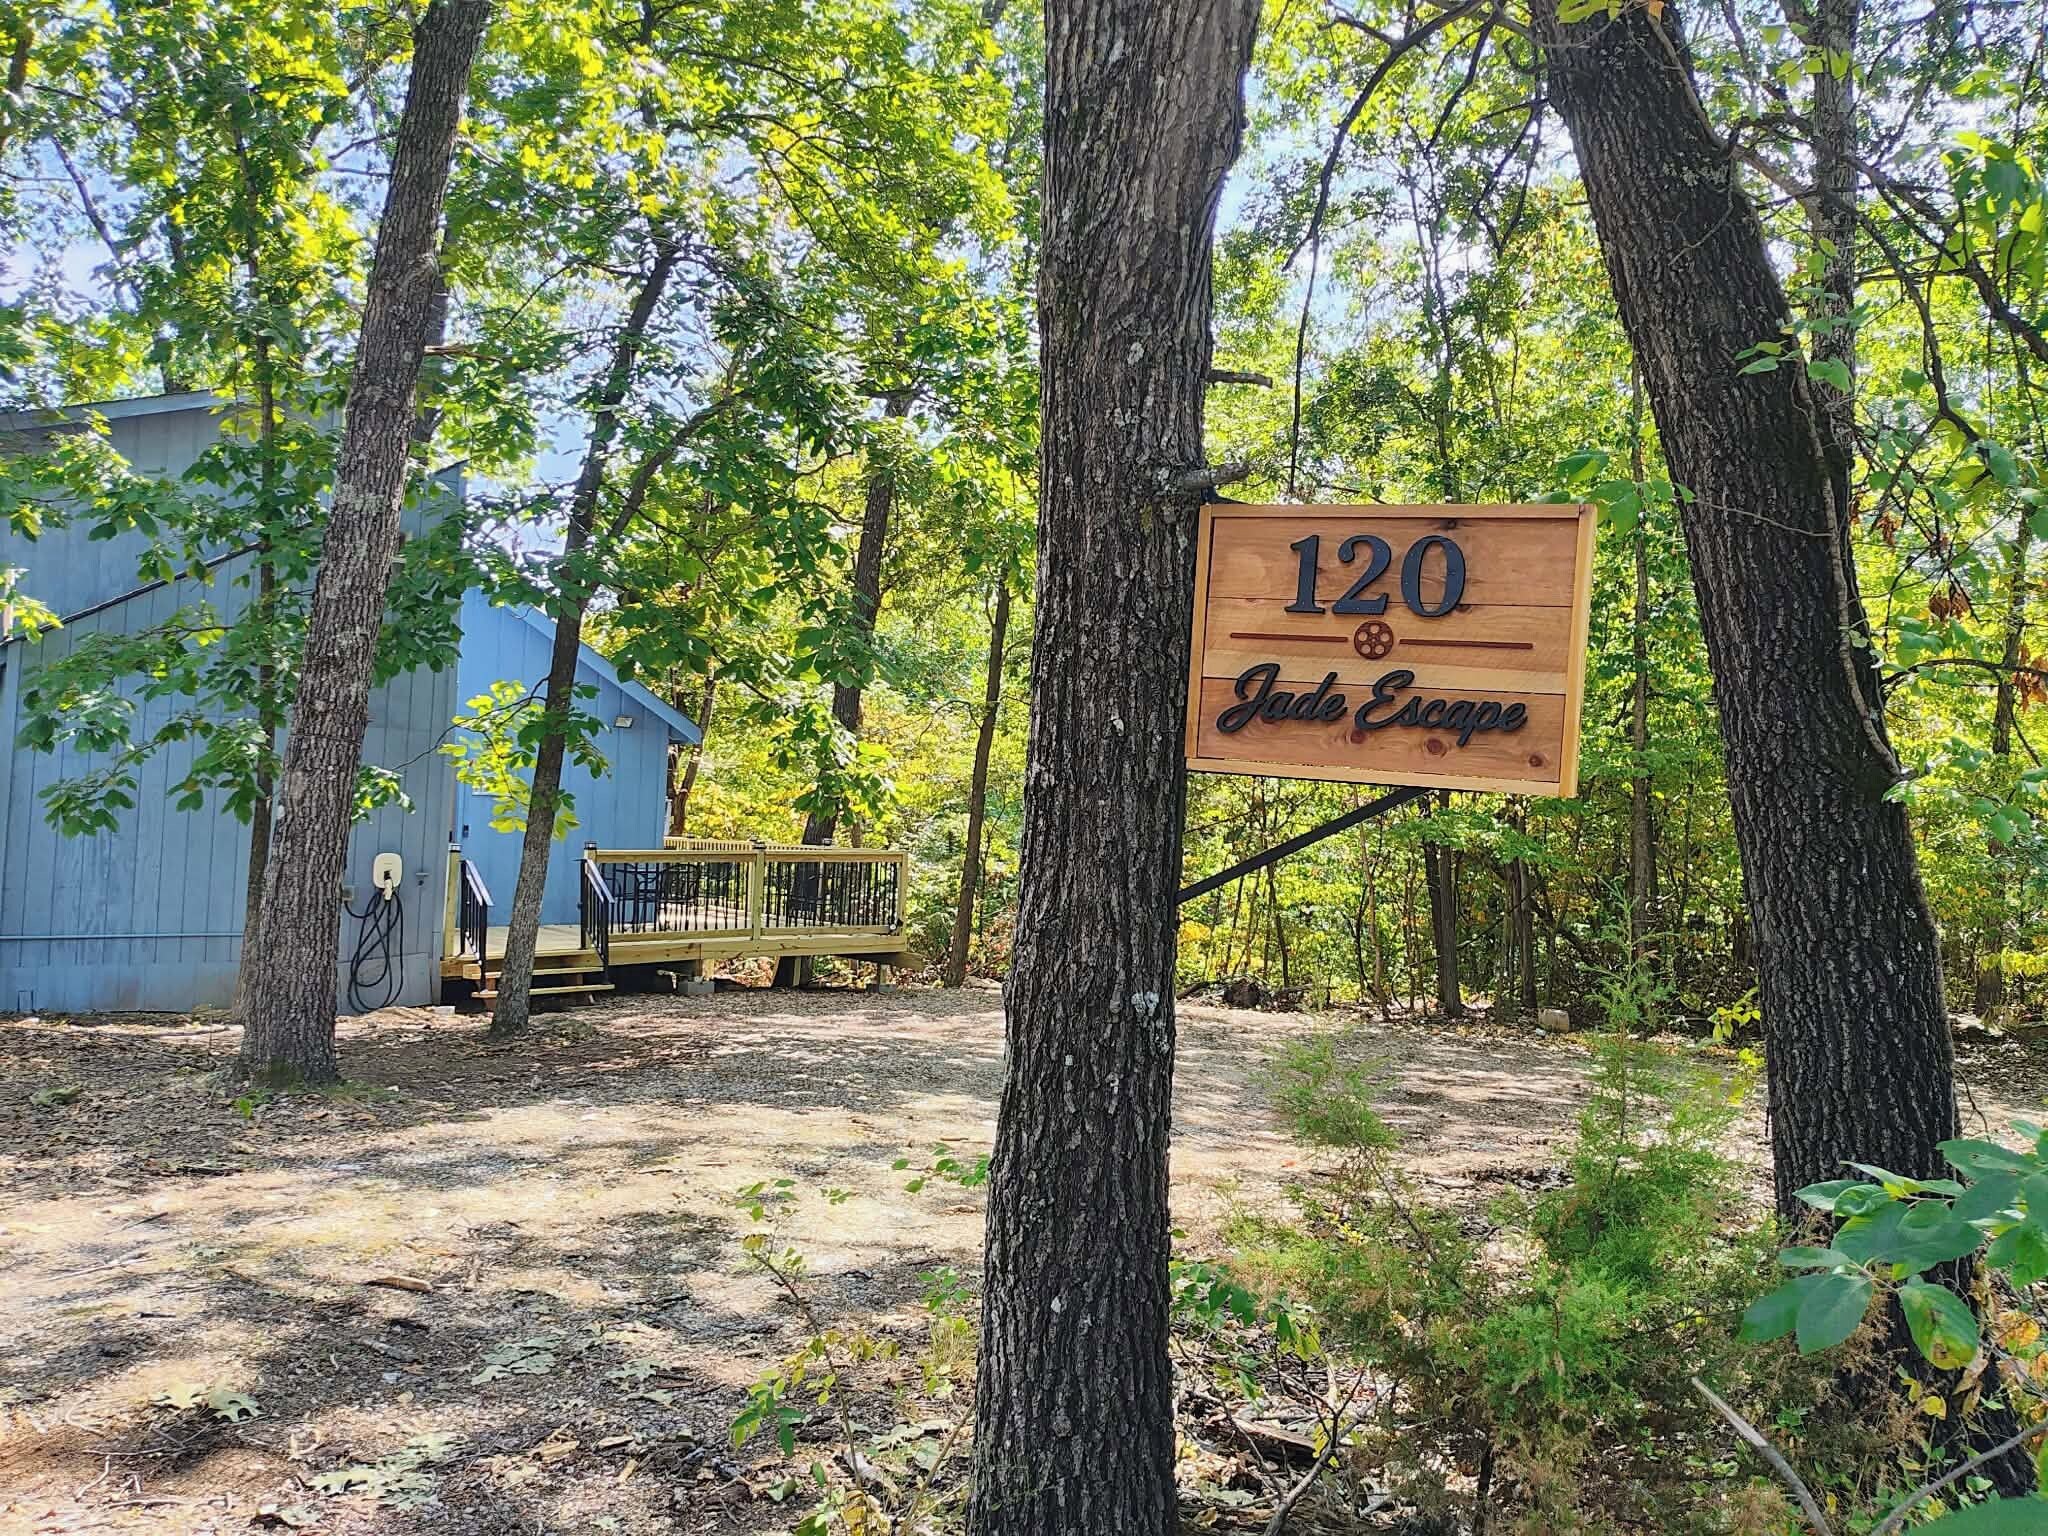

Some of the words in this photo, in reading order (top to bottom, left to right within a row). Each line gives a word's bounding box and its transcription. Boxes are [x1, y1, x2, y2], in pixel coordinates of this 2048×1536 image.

[1285, 534, 1466, 617] 120
[1216, 663, 1347, 733] Jade
[1354, 670, 1528, 747] Escape
